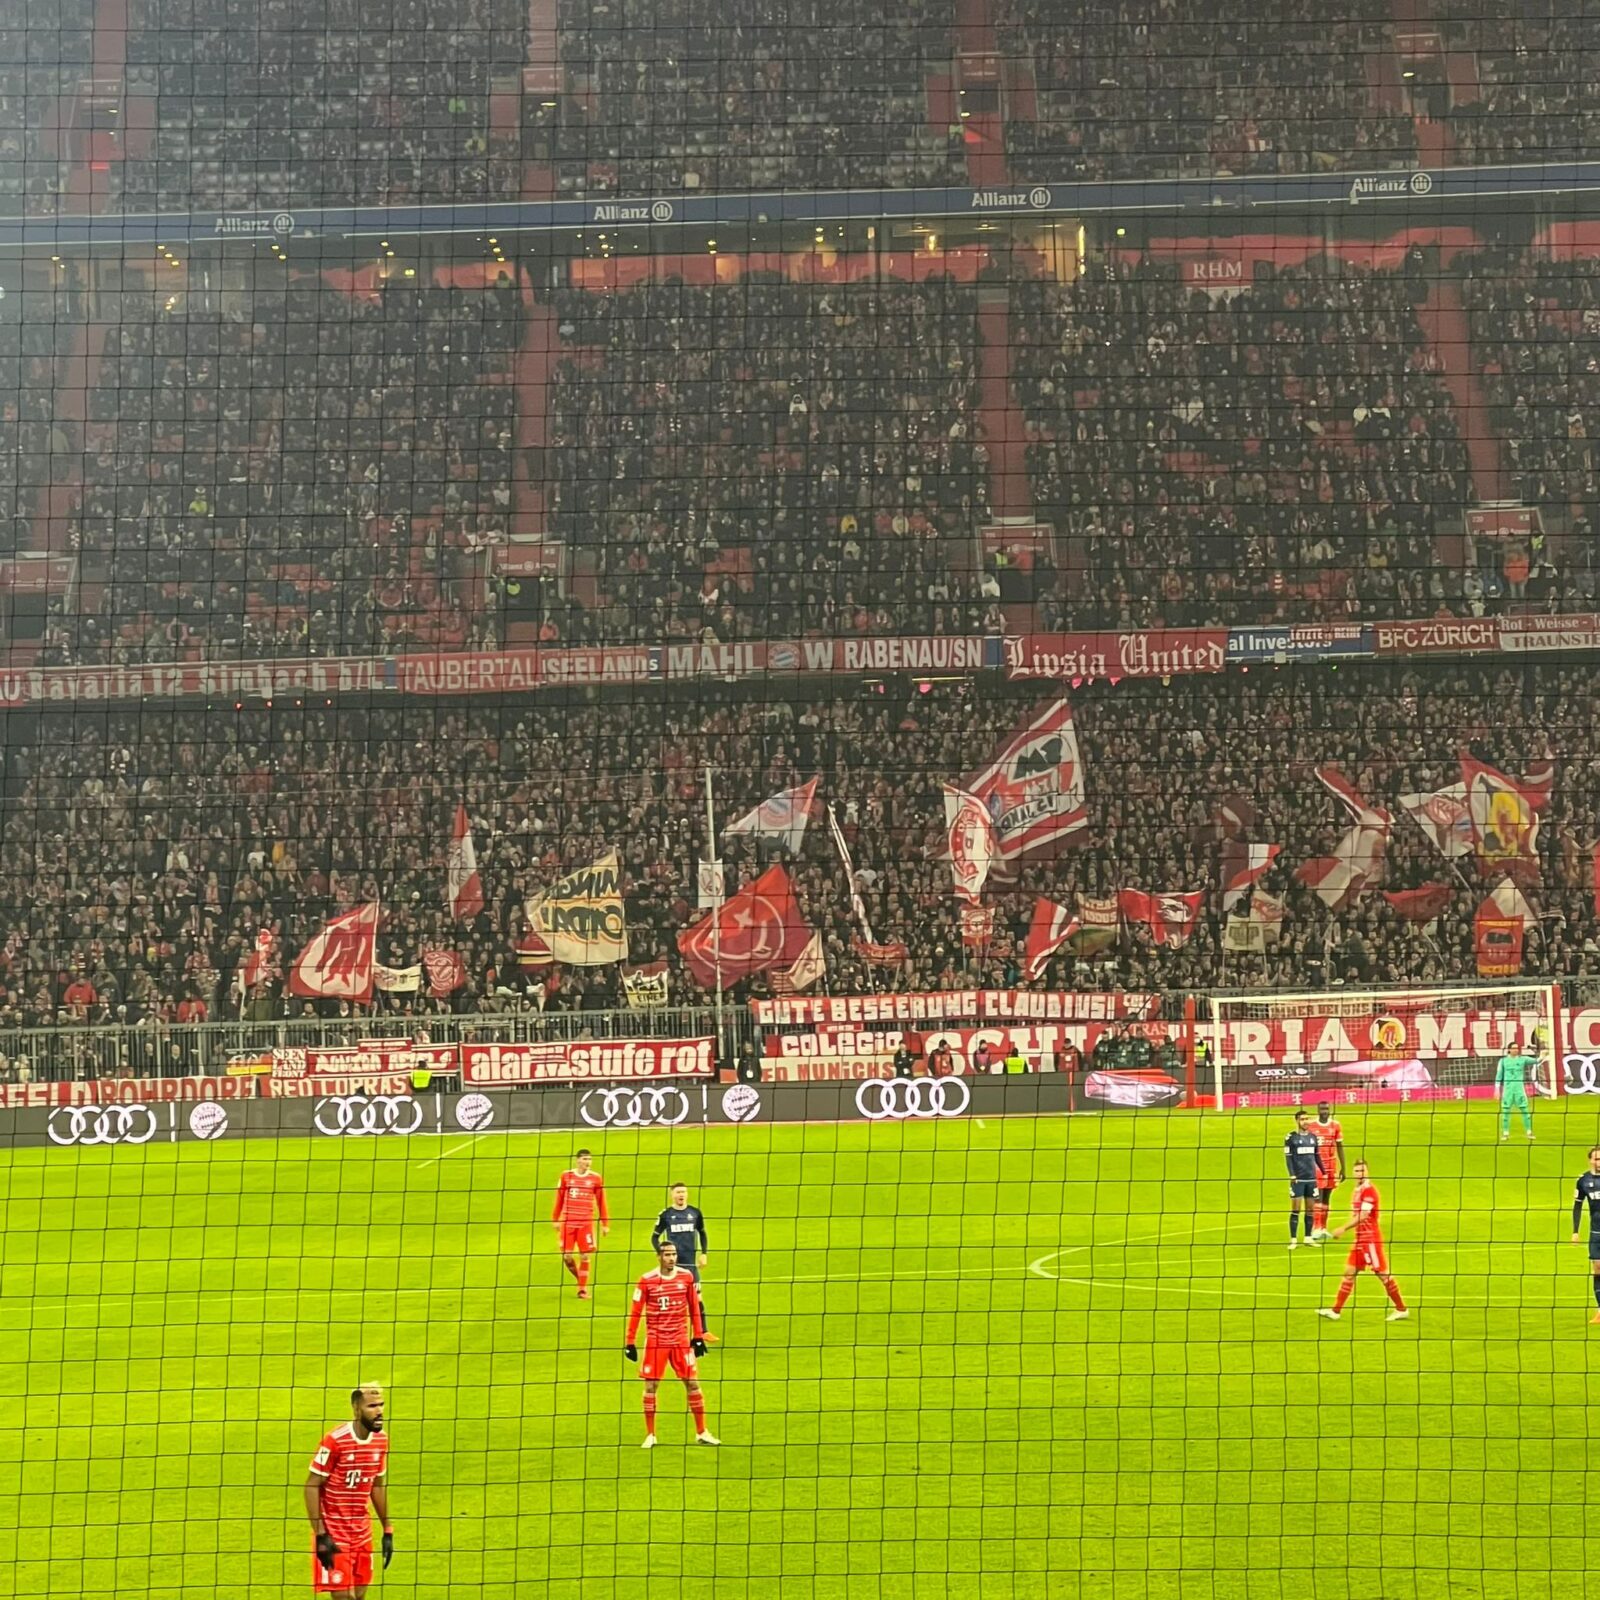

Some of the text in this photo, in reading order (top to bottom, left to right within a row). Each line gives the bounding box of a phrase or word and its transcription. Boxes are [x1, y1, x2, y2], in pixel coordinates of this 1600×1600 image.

[1351, 178, 1407, 193] Allianz
[971, 192, 1027, 207] Allianz
[215, 218, 270, 232] Allianz
[594, 206, 649, 221] Allianz
[1193, 261, 1242, 279] RHM
[1378, 624, 1495, 649] BFC ZÜRICH
[1501, 618, 1522, 630] Rot
[844, 639, 982, 668] RABENAU/SN
[1003, 634, 1224, 678] Lipsia United
[28, 669, 143, 700] Bavaria
[200, 662, 327, 696] Simbach
[339, 661, 384, 691] b/L
[399, 657, 537, 691] TAUBERTAL
[547, 656, 648, 682] SEELAND
[758, 999, 825, 1024] GUTE
[830, 992, 977, 1024] BESSERUNG
[985, 992, 1115, 1020] CLAUDIUS!!
[661, 1040, 712, 1074] rot
[269, 1078, 313, 1097] RED
